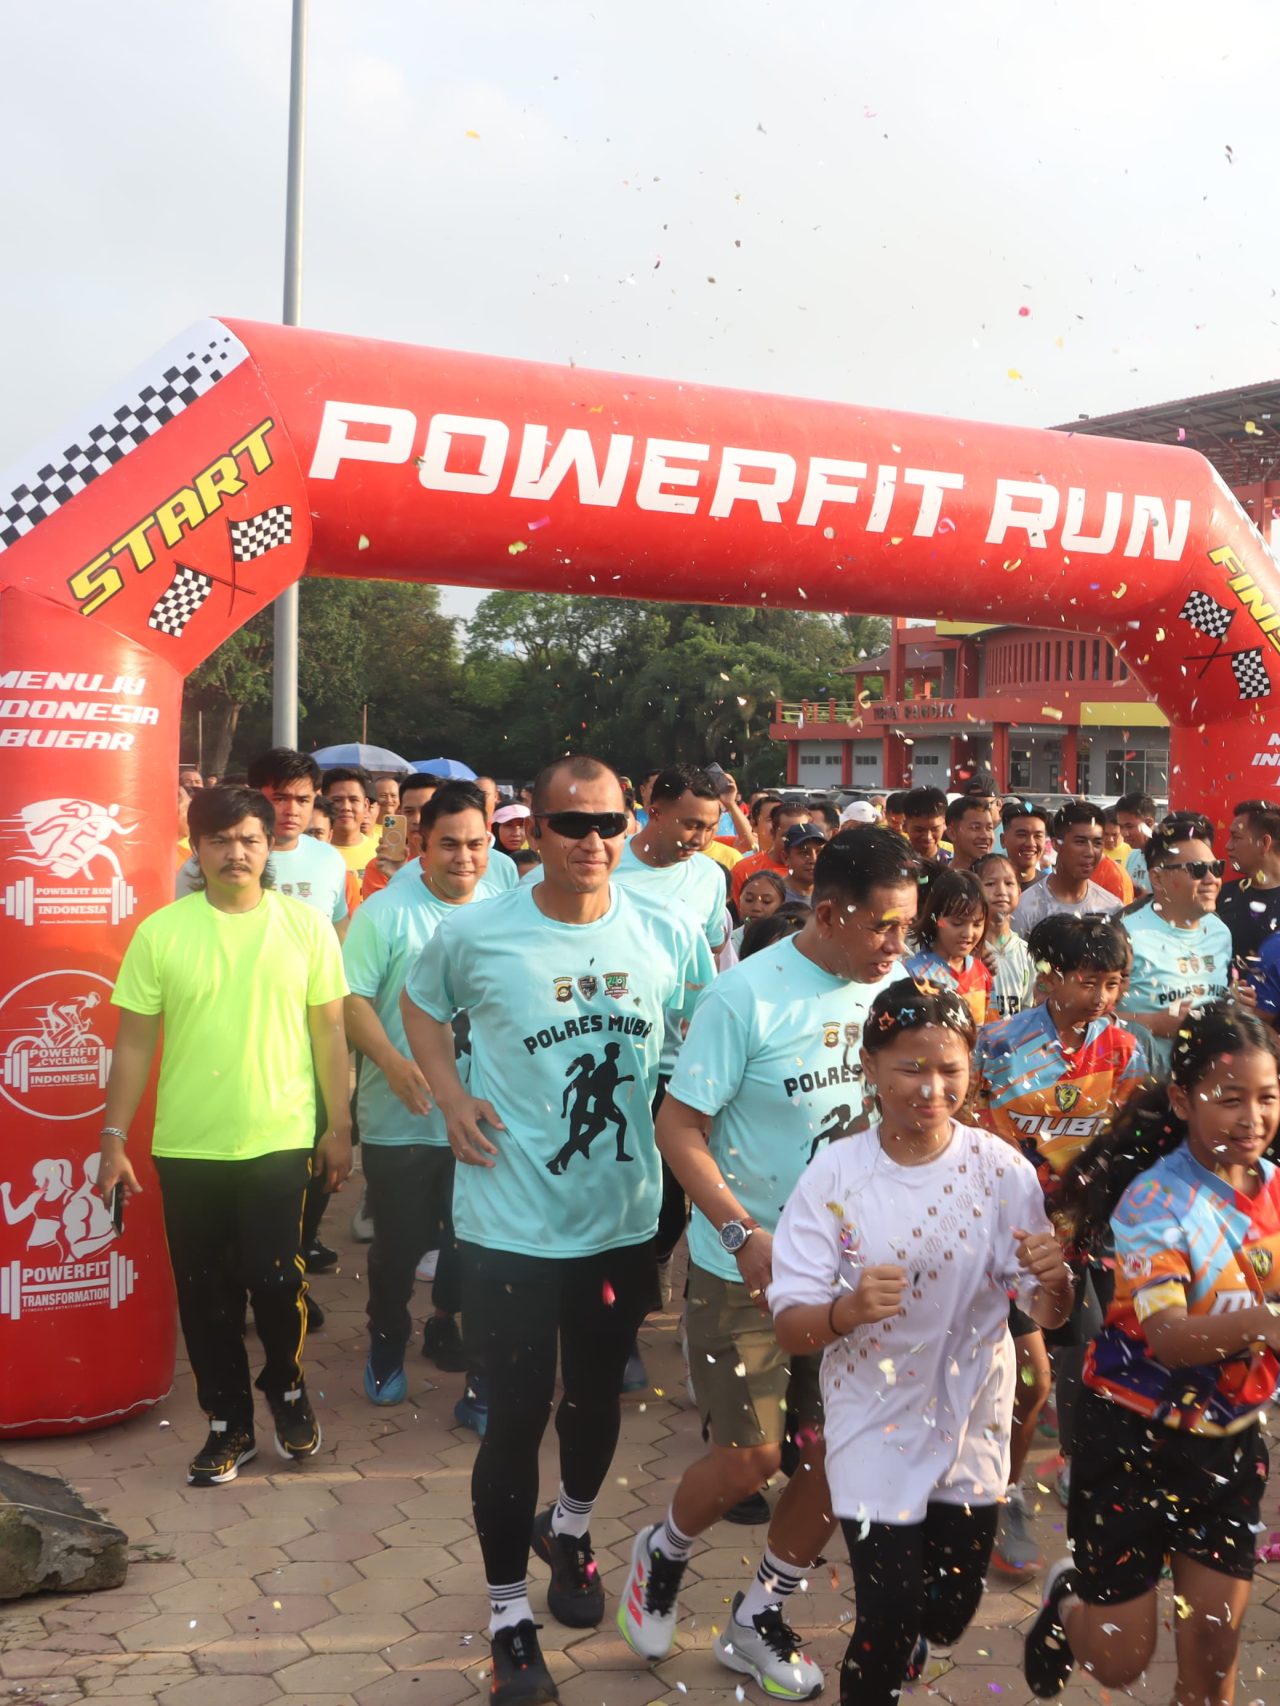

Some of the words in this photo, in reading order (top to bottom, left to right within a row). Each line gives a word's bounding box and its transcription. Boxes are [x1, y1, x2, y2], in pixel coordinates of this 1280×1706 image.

[308, 400, 963, 538] POWERFIT
[985, 478, 1191, 561] RUN
[67, 417, 275, 616] START
[0, 700, 159, 726] DONESIA
[0, 729, 135, 751] BUGAR
[36, 887, 90, 895] POWERFIT
[92, 887, 111, 895] RUN
[38, 905, 107, 914] INDONESIA
[523, 1014, 603, 1055] POLRES
[30, 1047, 98, 1058] POWERFIT
[41, 1057, 88, 1066] CYCLING
[31, 1073, 97, 1084] INDONESIA
[783, 1064, 862, 1097] POLRES
[22, 1261, 109, 1283] POWERFIT
[22, 1287, 110, 1307] TRANSFORMATION
